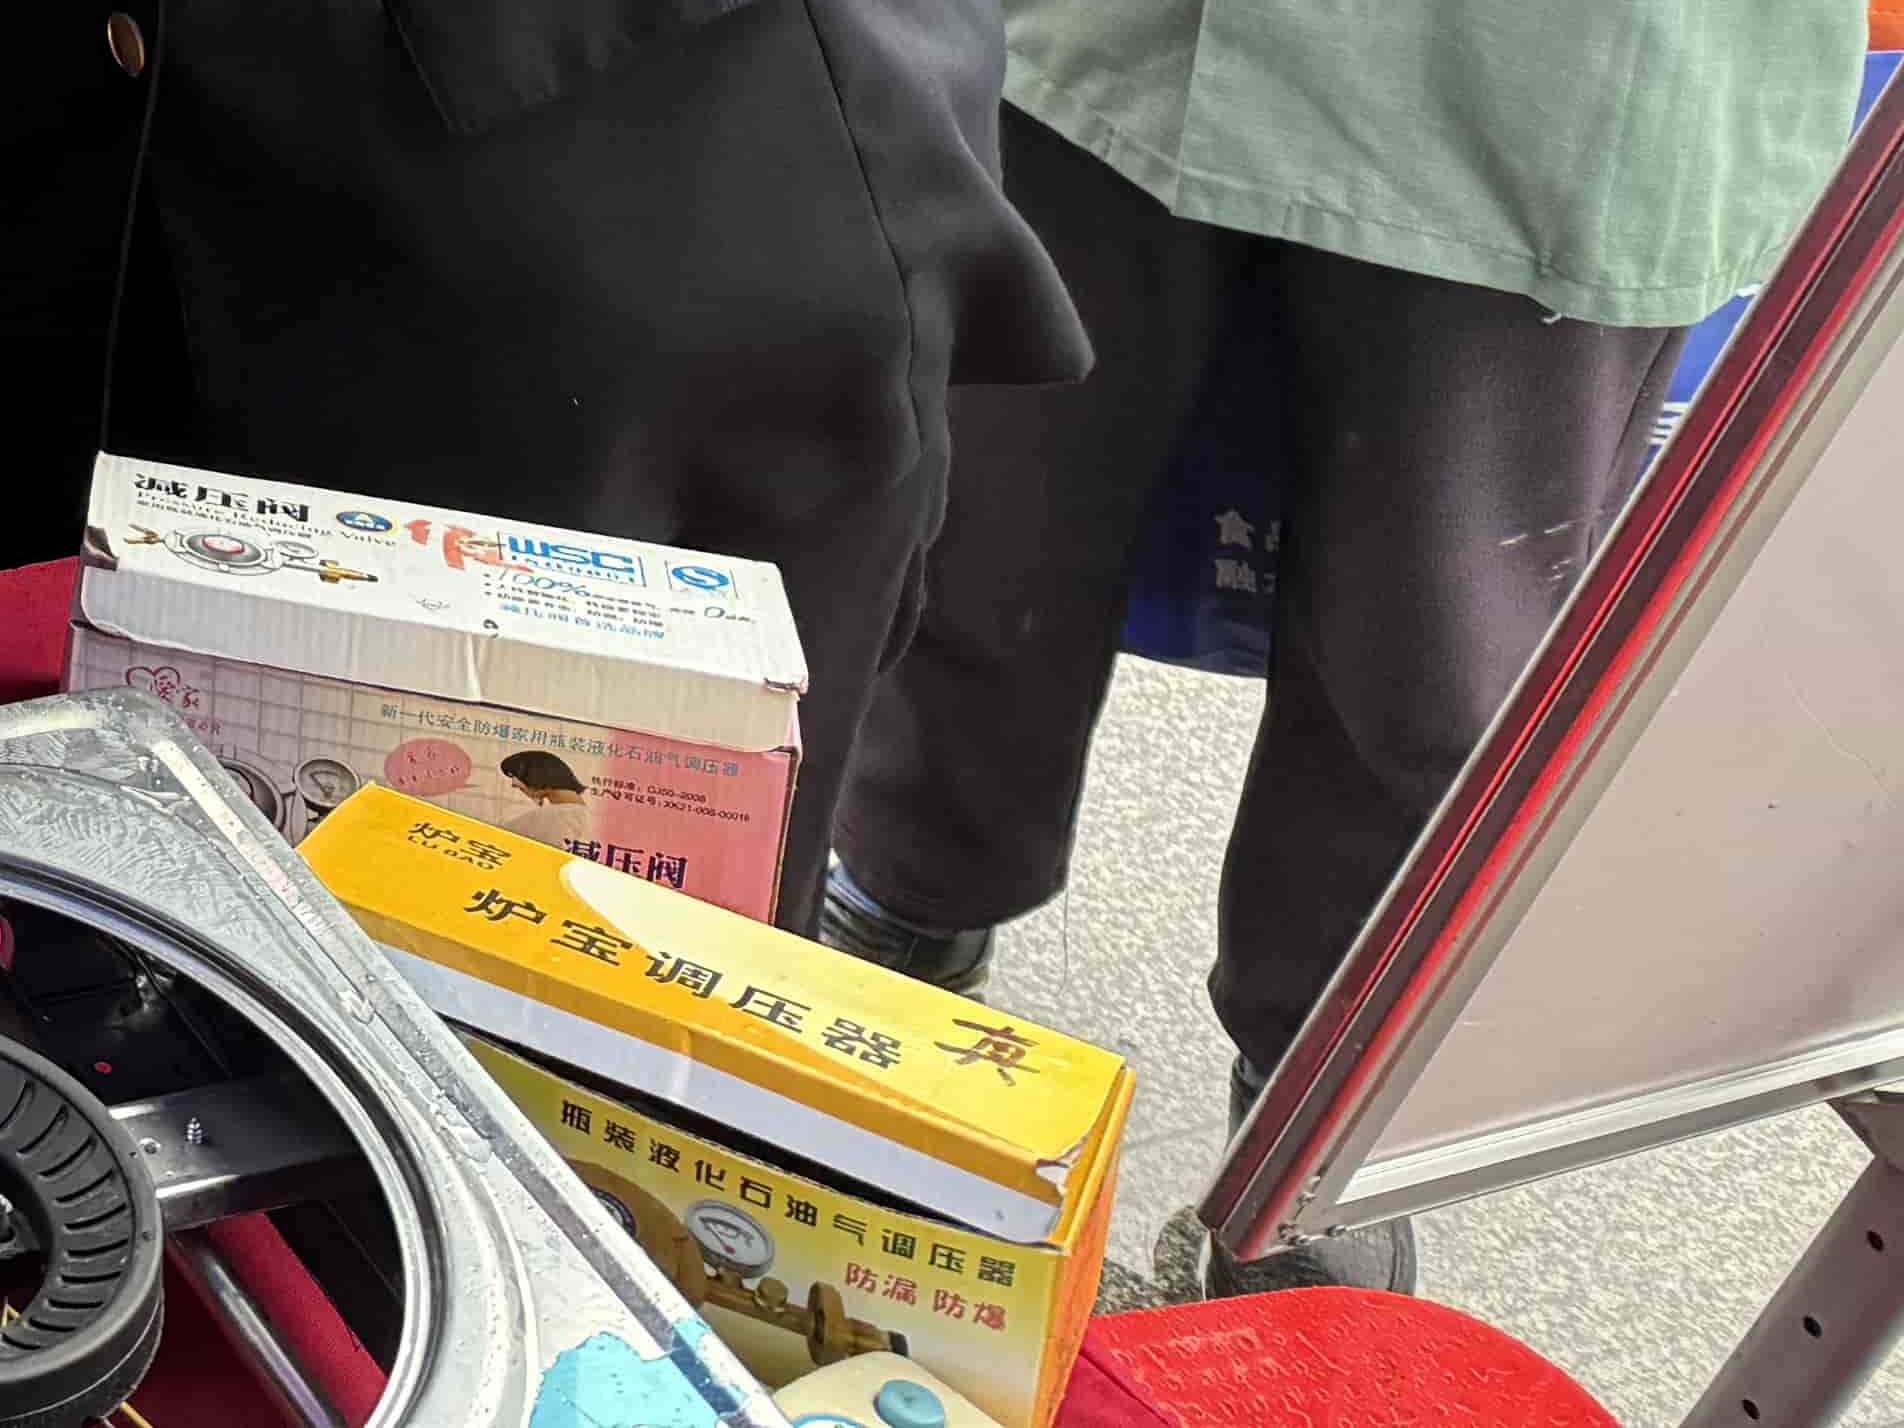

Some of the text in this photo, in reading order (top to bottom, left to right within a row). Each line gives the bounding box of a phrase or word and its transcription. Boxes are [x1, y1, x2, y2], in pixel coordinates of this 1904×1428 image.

[407, 821, 513, 869] 炉宝
[563, 837, 688, 890] 减压阀
[463, 888, 904, 1071] 炉宝调压器
[560, 1099, 1018, 1288] 瓶装液化石油气调压器
